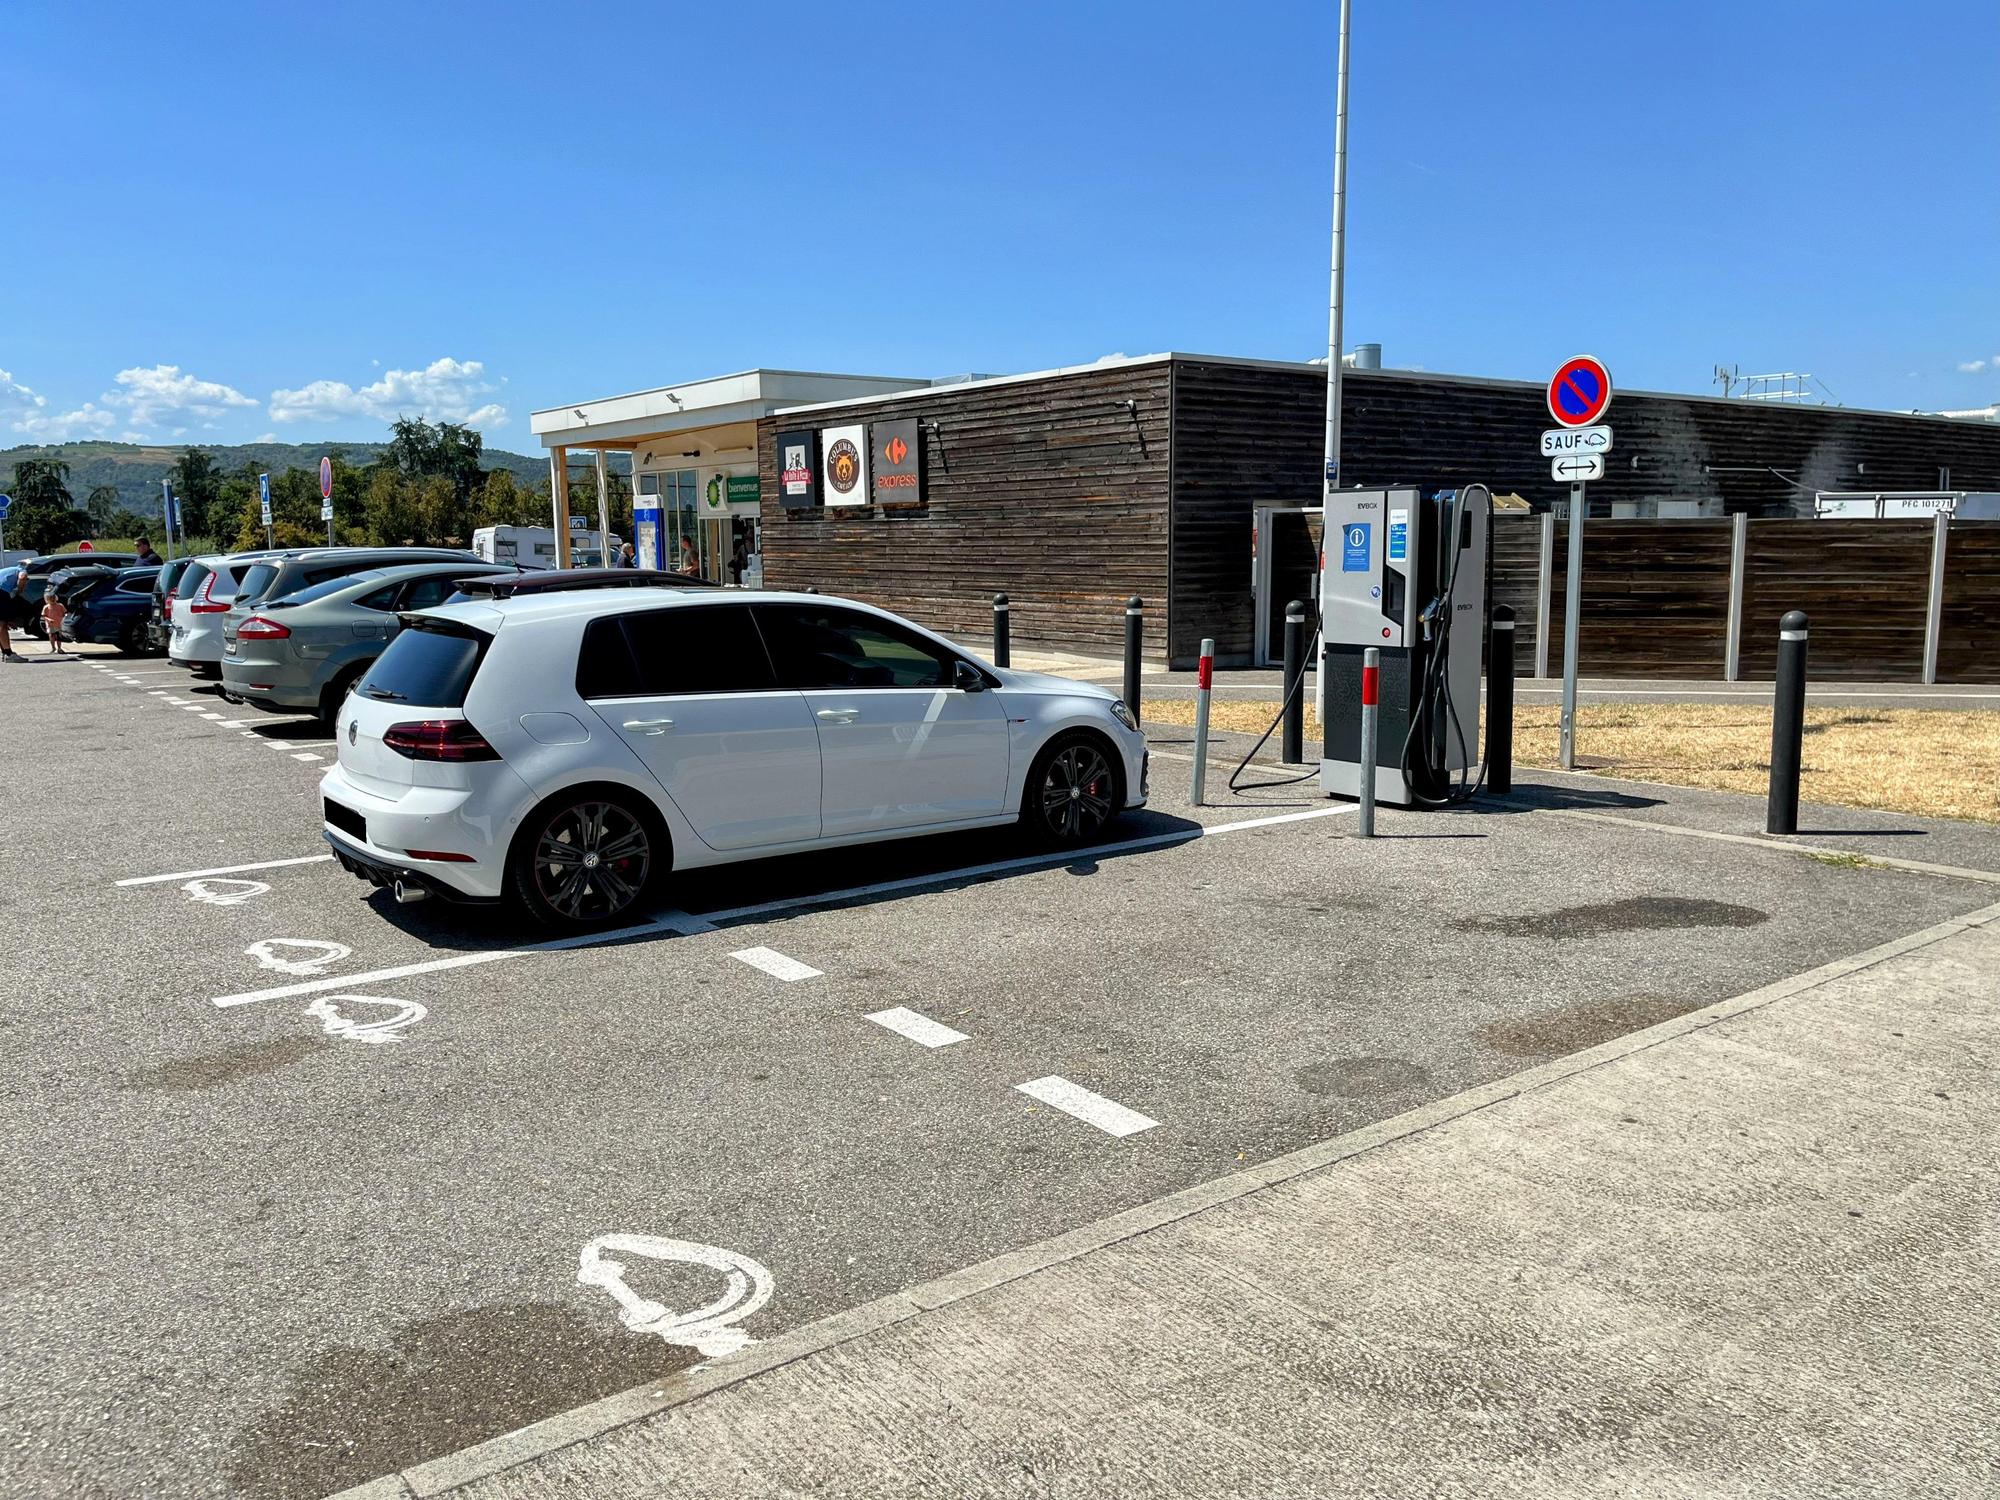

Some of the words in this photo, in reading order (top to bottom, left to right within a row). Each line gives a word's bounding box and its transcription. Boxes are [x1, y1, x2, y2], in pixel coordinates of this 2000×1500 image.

[1544, 434, 1582, 450] SAUF
[829, 441, 859, 464] COLUMBUS
[728, 482, 758, 493] bienvenue
[878, 474, 916, 490] express
[1357, 502, 1378, 510] EVBOX
[1902, 500, 1919, 508] PFC
[1922, 500, 1950, 508] 101271
